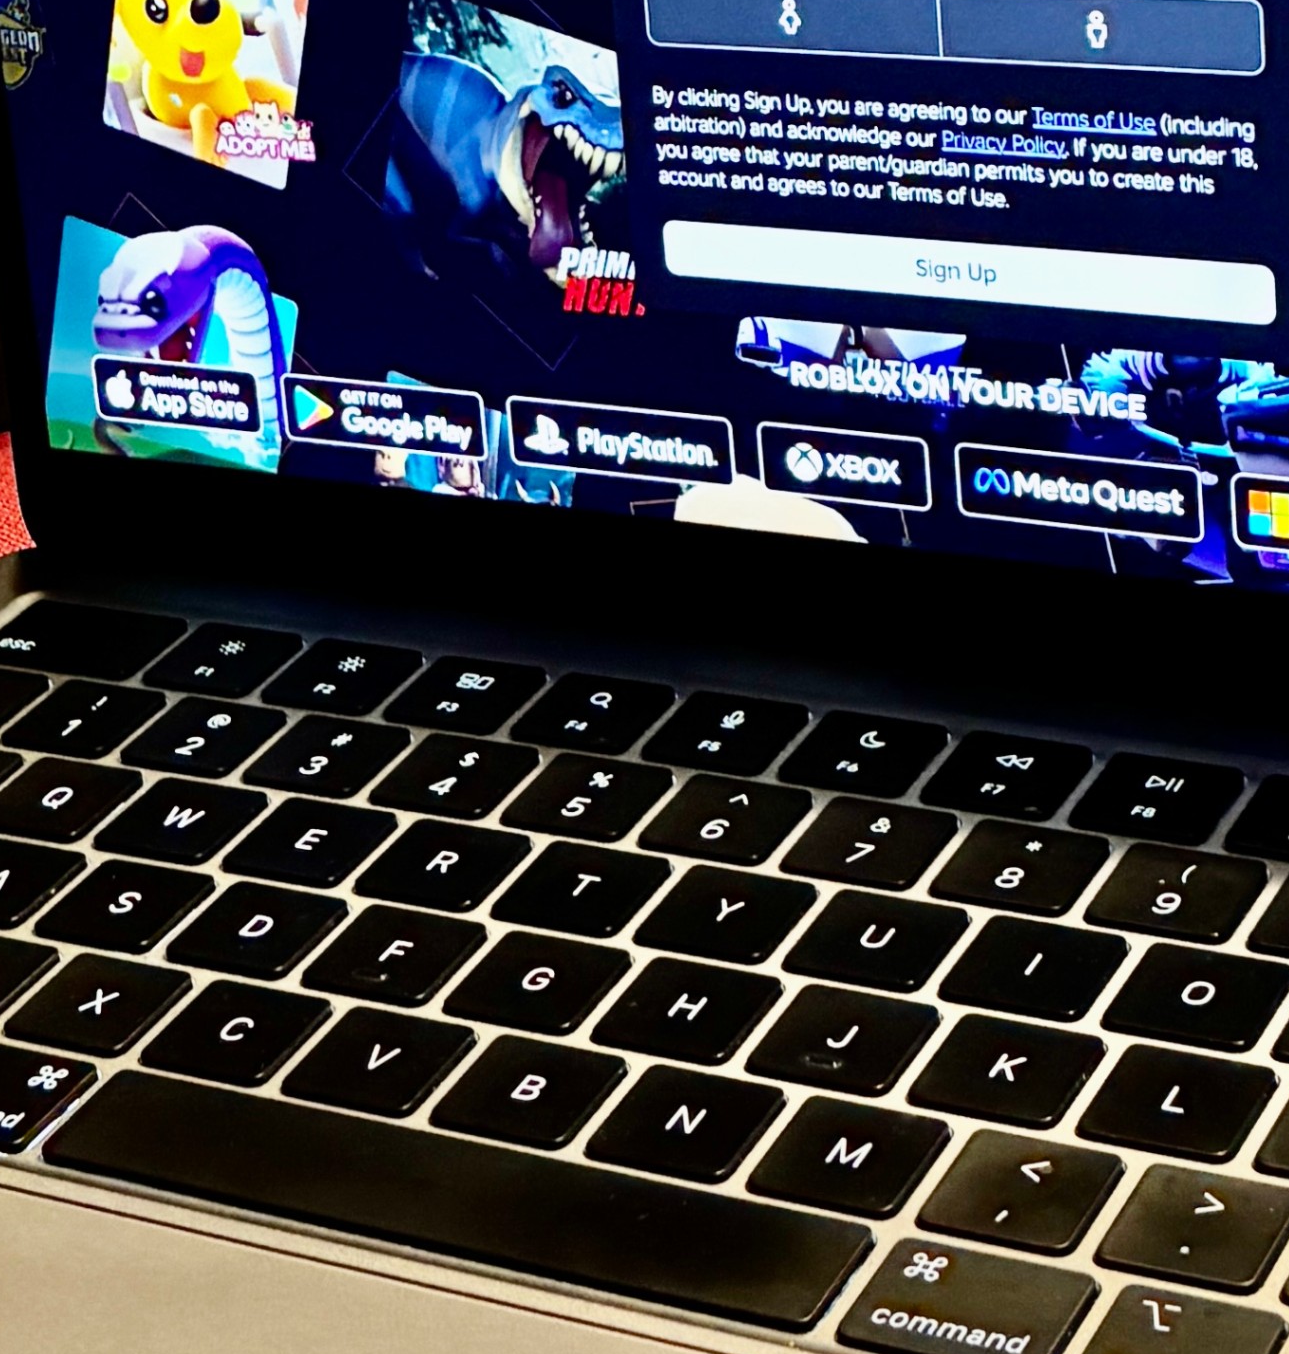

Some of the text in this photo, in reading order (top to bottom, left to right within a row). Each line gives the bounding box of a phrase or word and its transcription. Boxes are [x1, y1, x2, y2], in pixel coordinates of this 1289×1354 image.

[652, 85, 674, 108] By
[678, 88, 740, 113] clicking
[744, 90, 782, 115] Sign
[816, 97, 849, 117] you
[854, 101, 883, 115] are
[888, 101, 967, 126] agreeing
[971, 105, 991, 123] to
[995, 109, 1027, 124] our
[1032, 107, 1089, 127] Terms
[1094, 111, 1114, 130] of
[1119, 112, 1156, 131] Use
[1160, 113, 1255, 143] (including
[215, 134, 316, 162] ADOPT ME!
[654, 114, 746, 138] arbitration)
[750, 121, 782, 138] and
[787, 124, 902, 149] acknowledge
[906, 131, 936, 147] our
[942, 130, 1006, 153] Privacy
[1073, 137, 1086, 156] If
[1092, 142, 1126, 162] you
[1132, 145, 1163, 162] are
[1168, 145, 1226, 165] under
[656, 143, 1215, 194] you agree that your parent/guardian permits you to create this
[658, 169, 1010, 208] account and agrees to our Terms of Use.
[915, 257, 997, 286] Sign Up
[339, 389, 402, 409] GET IT ON
[790, 361, 902, 397] ROBLOX
[908, 373, 950, 401] ON
[956, 377, 1033, 409] YOUR
[1039, 385, 1147, 421] DEVICE
[141, 389, 249, 422] App Store
[341, 407, 472, 450] Google Play
[826, 453, 902, 486] XBOX
[1013, 473, 1184, 516] Meta Quest
[41, 786, 74, 810] Q
[163, 805, 206, 829] W
[294, 828, 328, 851] E
[425, 850, 460, 874] R
[572, 873, 602, 897] T
[108, 891, 142, 914] S
[238, 914, 274, 938] D
[378, 939, 414, 962] F
[521, 966, 556, 991] G
[77, 988, 120, 1015] X
[667, 993, 708, 1021] H
[219, 1016, 255, 1042] C
[826, 1025, 859, 1049] J
[367, 1043, 402, 1071] V
[510, 1074, 547, 1101] B
[664, 1104, 707, 1135] N
[824, 1137, 873, 1169] M
